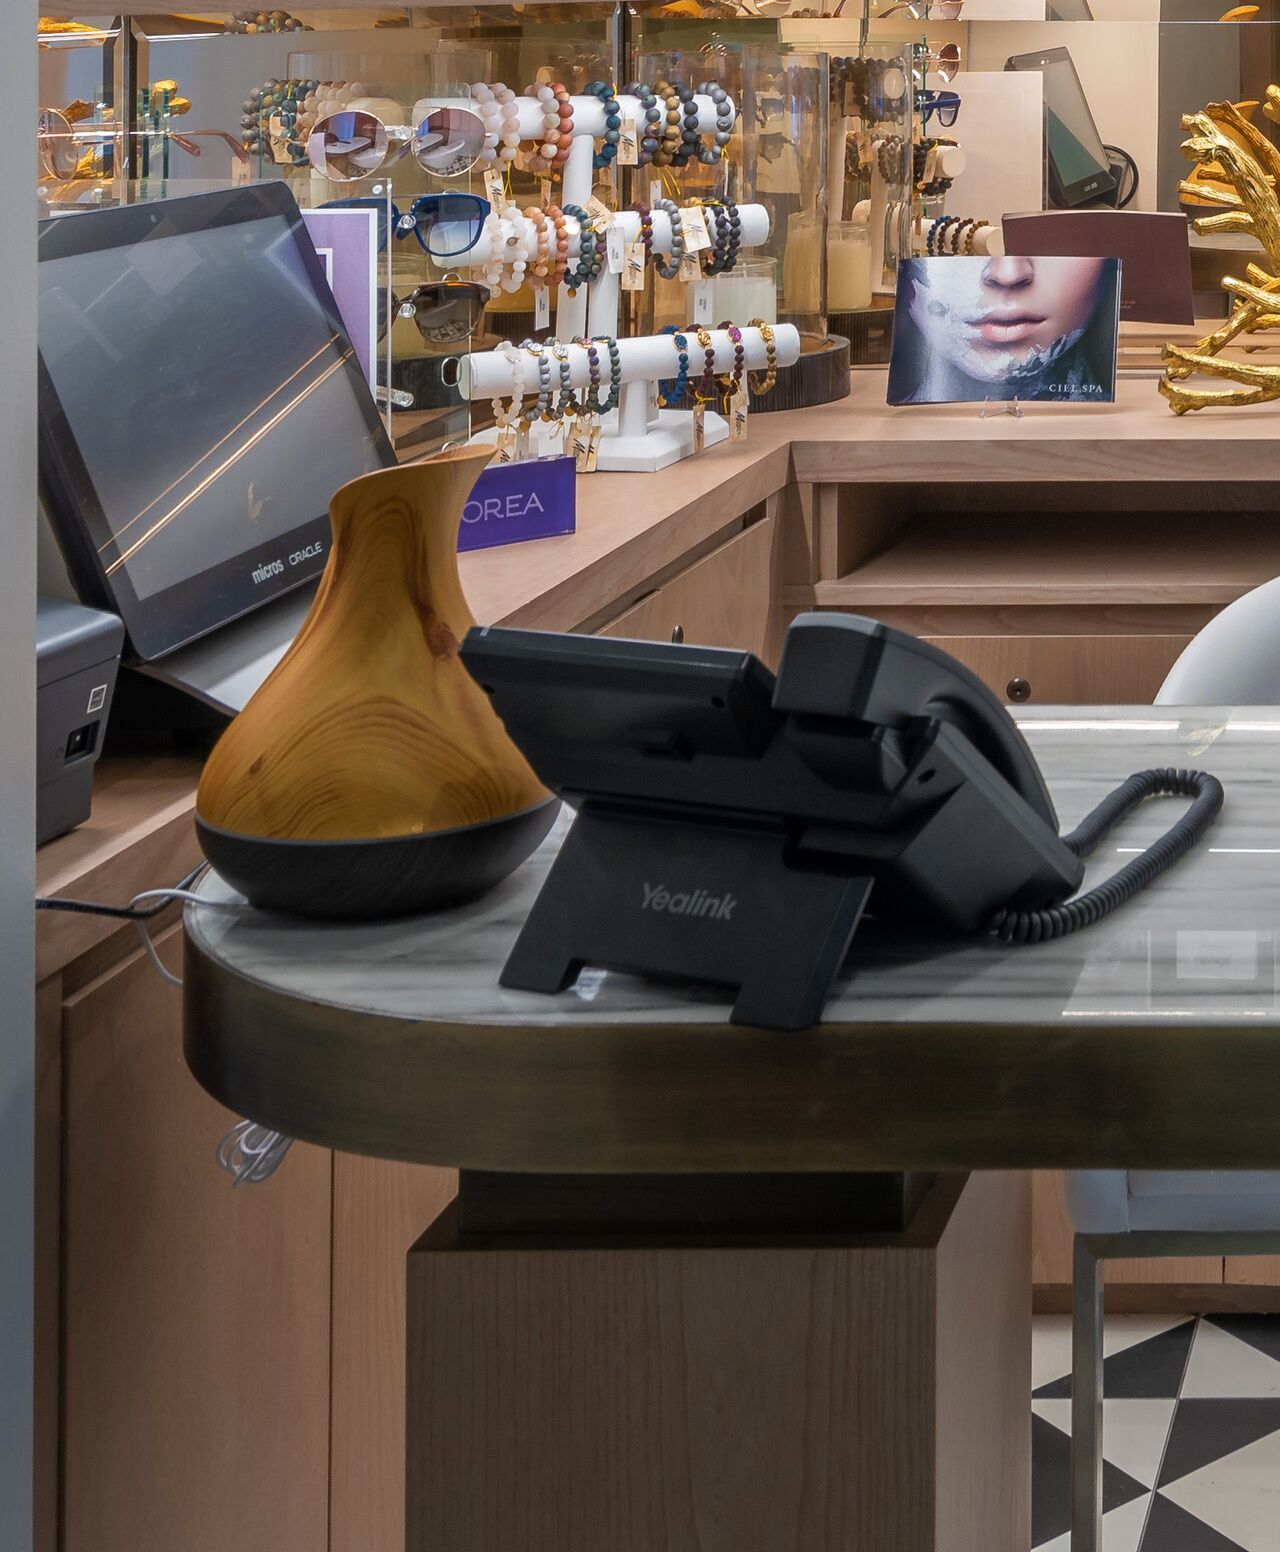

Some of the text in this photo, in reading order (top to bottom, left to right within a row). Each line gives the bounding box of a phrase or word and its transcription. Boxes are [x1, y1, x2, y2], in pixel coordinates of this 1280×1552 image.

[1048, 383, 1103, 393] CIEL SPA
[251, 541, 323, 584] micros ORACLE
[640, 881, 738, 920] Yealink
